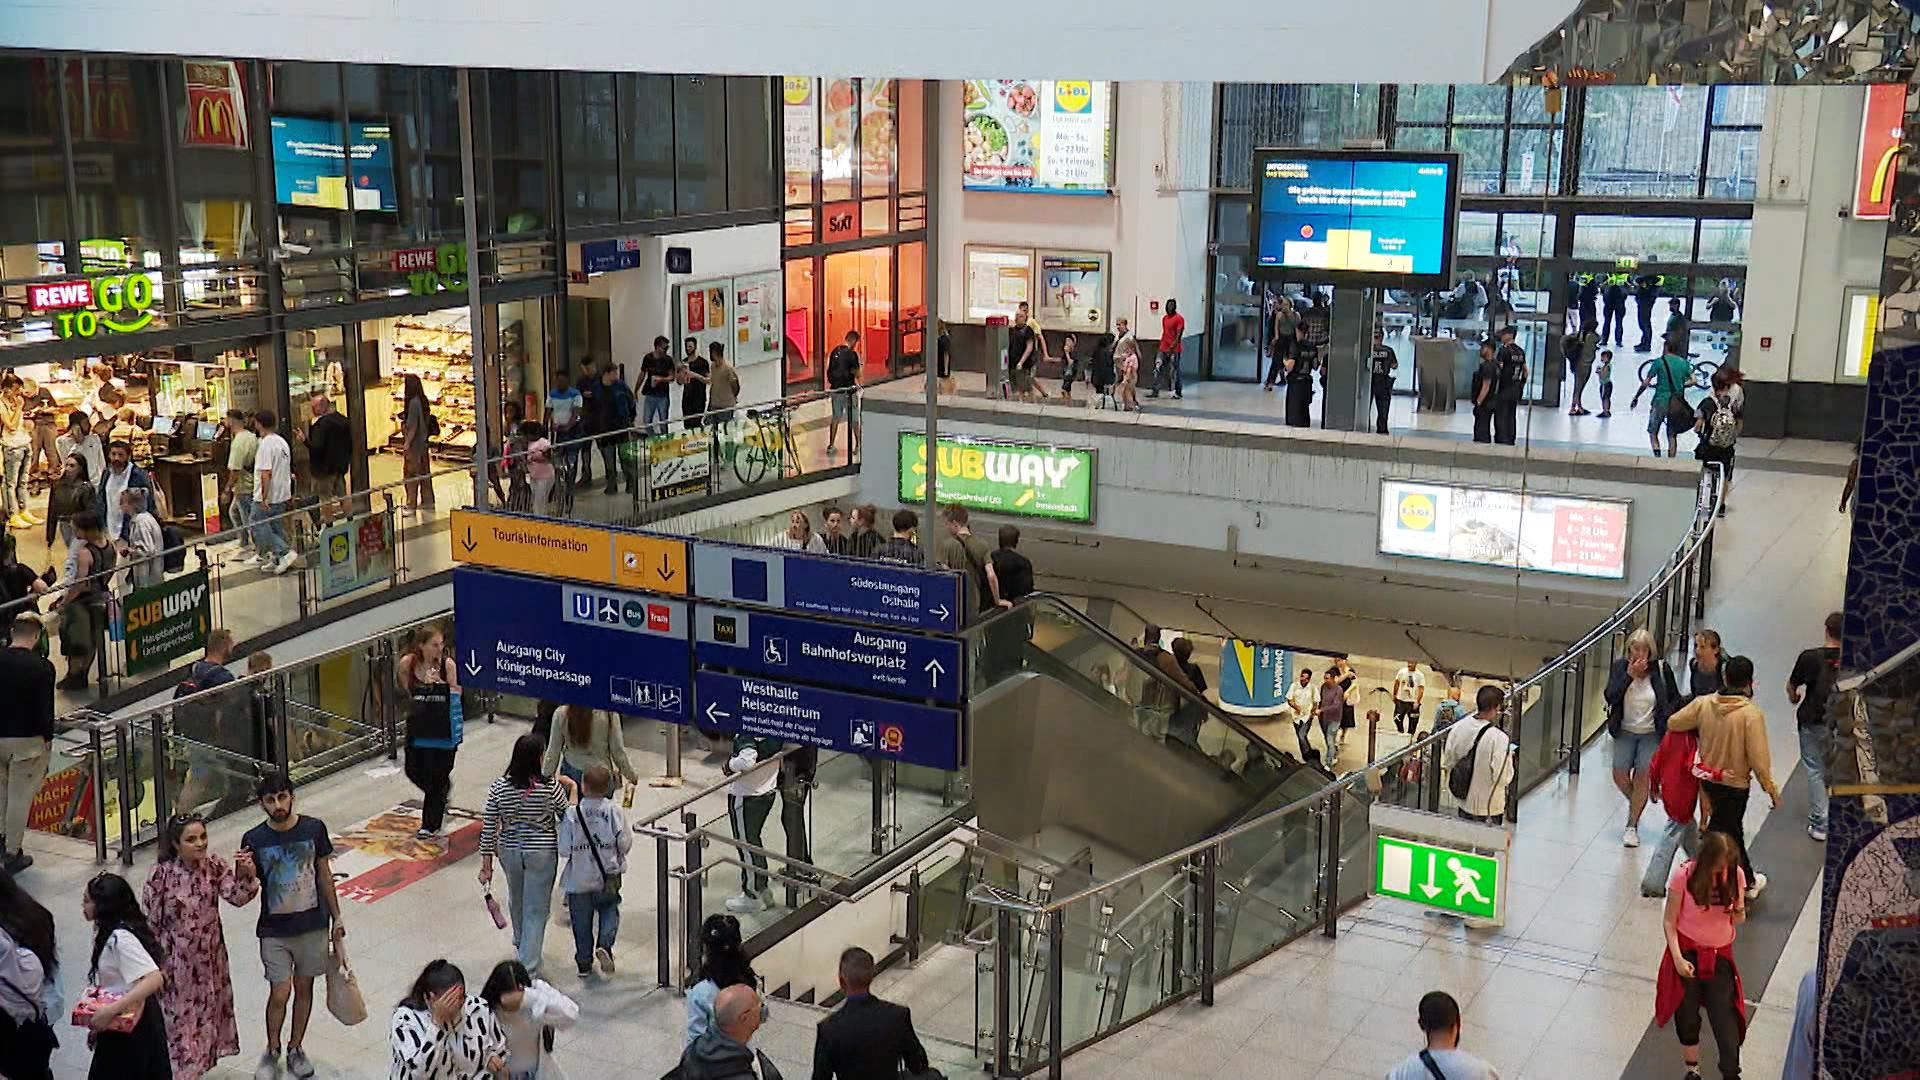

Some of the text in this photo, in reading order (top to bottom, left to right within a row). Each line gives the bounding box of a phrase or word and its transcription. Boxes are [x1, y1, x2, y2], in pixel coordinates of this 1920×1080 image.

[400, 251, 435, 268] REWE
[35, 273, 152, 312] REWE GO
[408, 271, 439, 296] TO
[58, 311, 97, 339] TO
[492, 527, 588, 553] Touristinformation
[850, 576, 920, 598] Südostausgang
[126, 583, 206, 632] SUBWAY
[881, 594, 920, 610] Osthalle
[626, 608, 668, 624] Bus Tram
[496, 641, 566, 665] Ausgang City
[853, 631, 907, 655] Ausgang
[801, 642, 907, 671] Bahnhofsvorplatz
[496, 657, 592, 687] Königstorpassage
[742, 679, 799, 701] Westhalle
[741, 695, 820, 721] Reisezentrum
